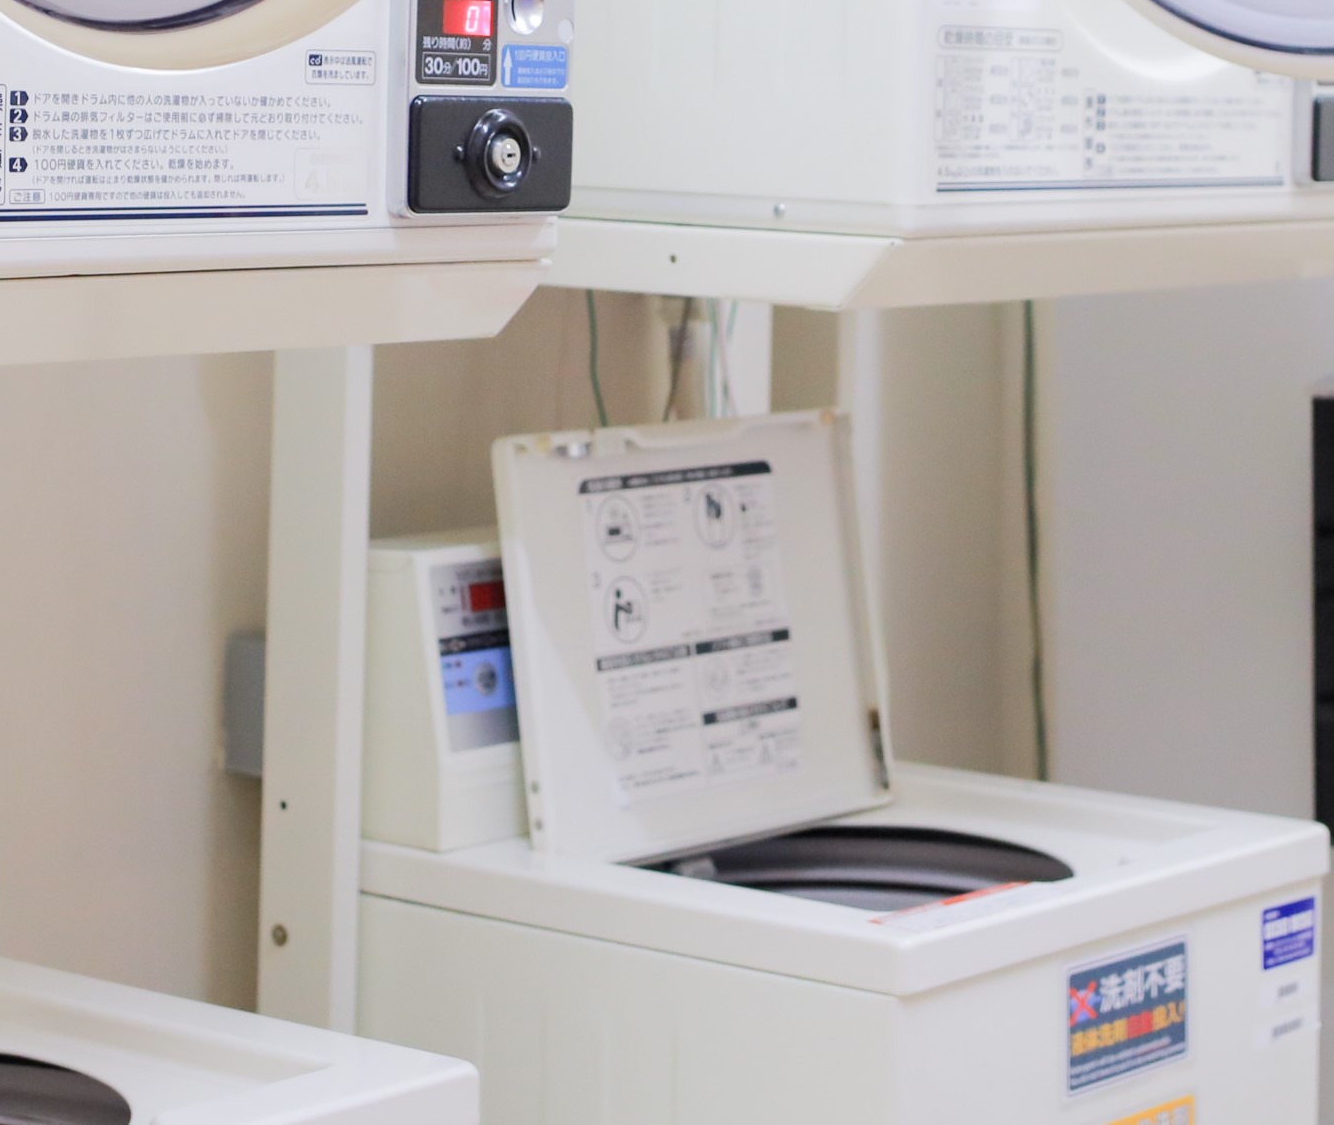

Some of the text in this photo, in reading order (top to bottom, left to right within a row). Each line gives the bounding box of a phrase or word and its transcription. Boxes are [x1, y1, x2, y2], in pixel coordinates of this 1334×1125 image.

[422, 36, 492, 52] 残り時間(約) 分
[424, 56, 488, 76] 30分/100円
[13, 191, 41, 202] ご注意
[1100, 953, 1185, 1013] 洗剤不要
